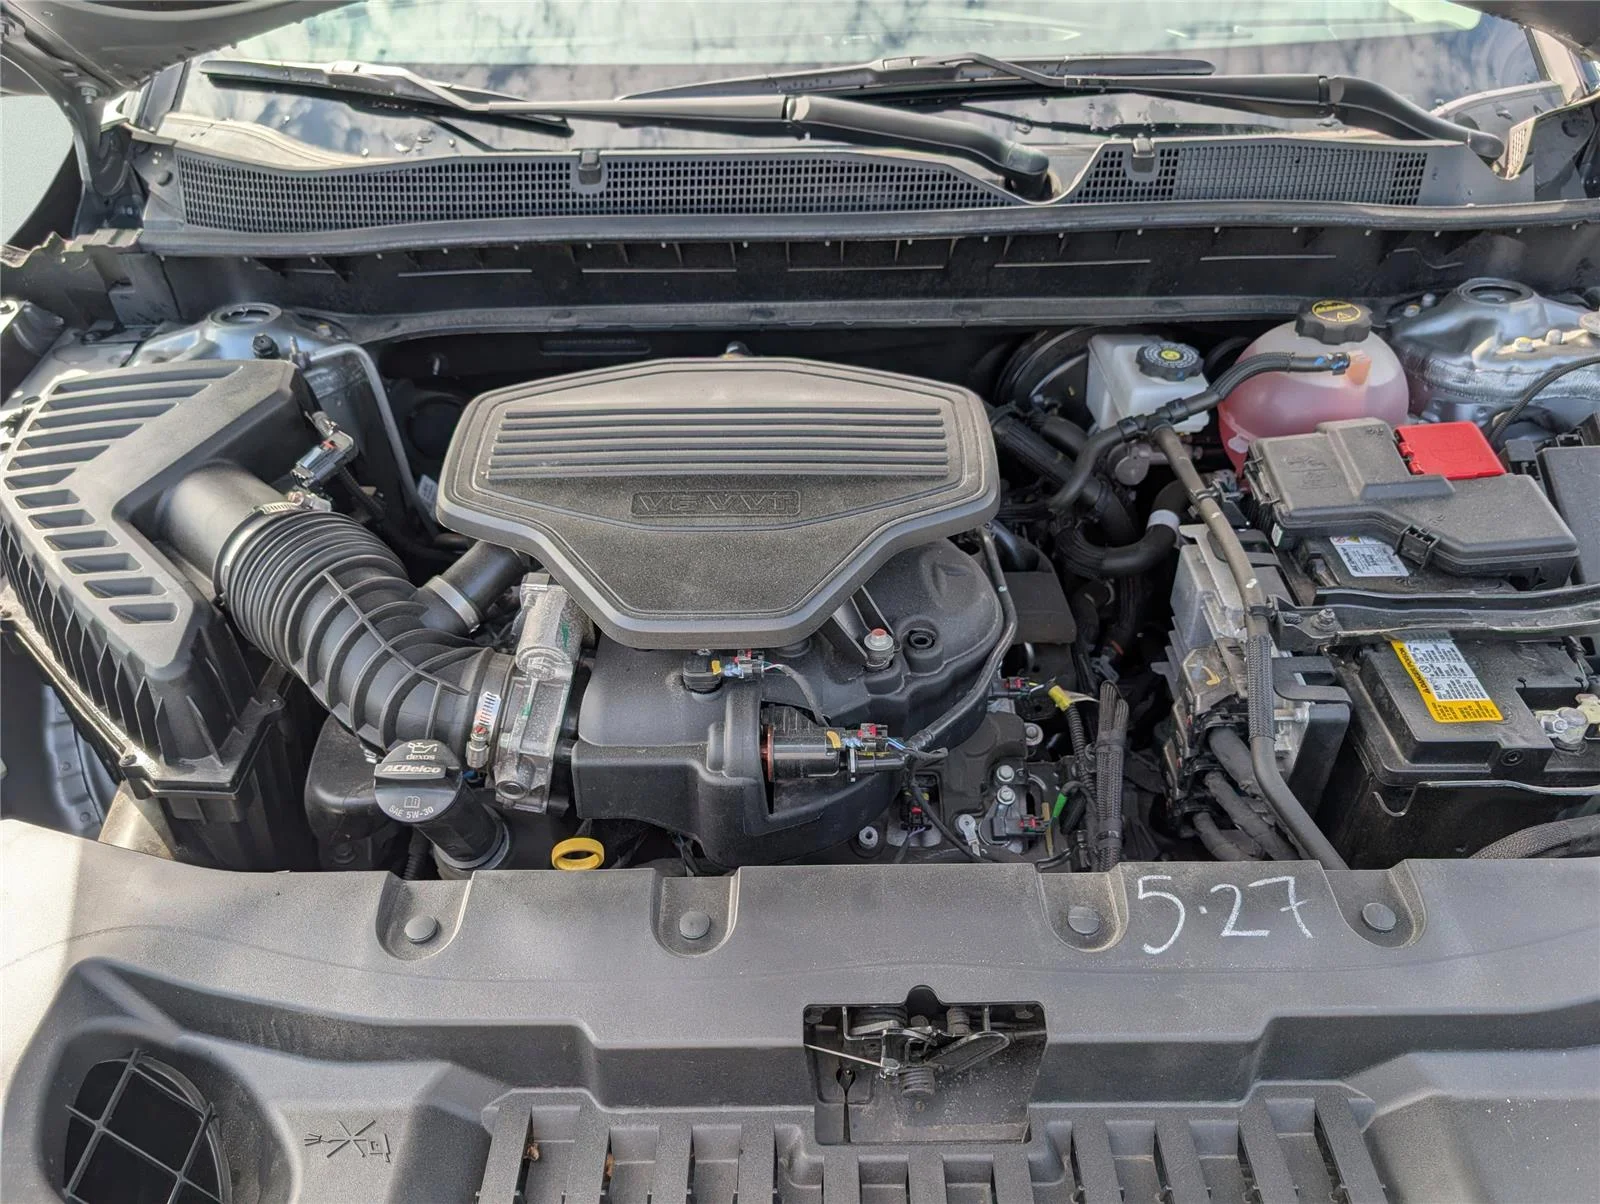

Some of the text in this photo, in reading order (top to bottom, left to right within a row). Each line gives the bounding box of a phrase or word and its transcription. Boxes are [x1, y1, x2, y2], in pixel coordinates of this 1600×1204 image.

[706, 494, 793, 512] VVT
[406, 753, 436, 761] dexos
[382, 764, 442, 774] ACDelco
[389, 804, 434, 819] SAE 5W-30
